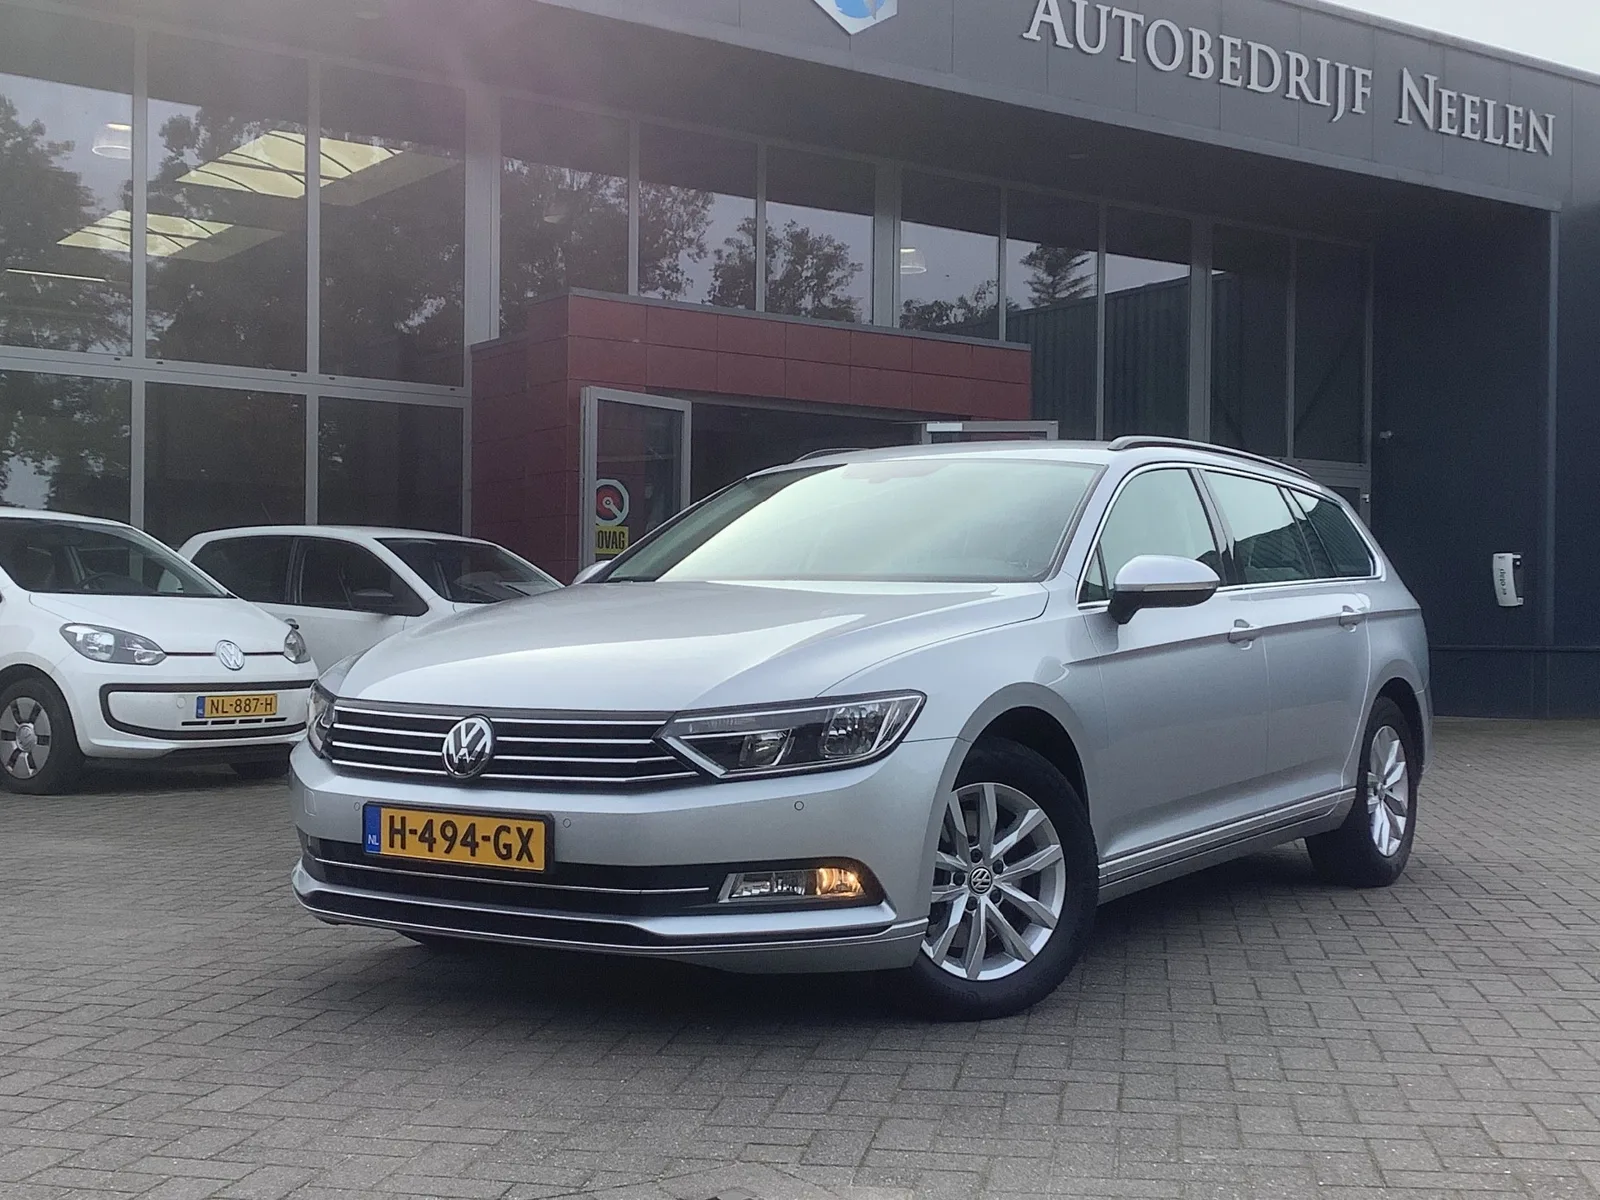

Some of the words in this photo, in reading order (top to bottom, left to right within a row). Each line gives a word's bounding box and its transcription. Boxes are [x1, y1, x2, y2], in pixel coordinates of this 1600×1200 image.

[1022, 0, 1373, 122] AUTOBEDRIJF
[1398, 67, 1556, 156] NEELEN
[596, 530, 625, 550] OVAG
[210, 697, 273, 714] NL-887-H
[367, 835, 379, 846] NL
[388, 815, 535, 863] H-494-GX
